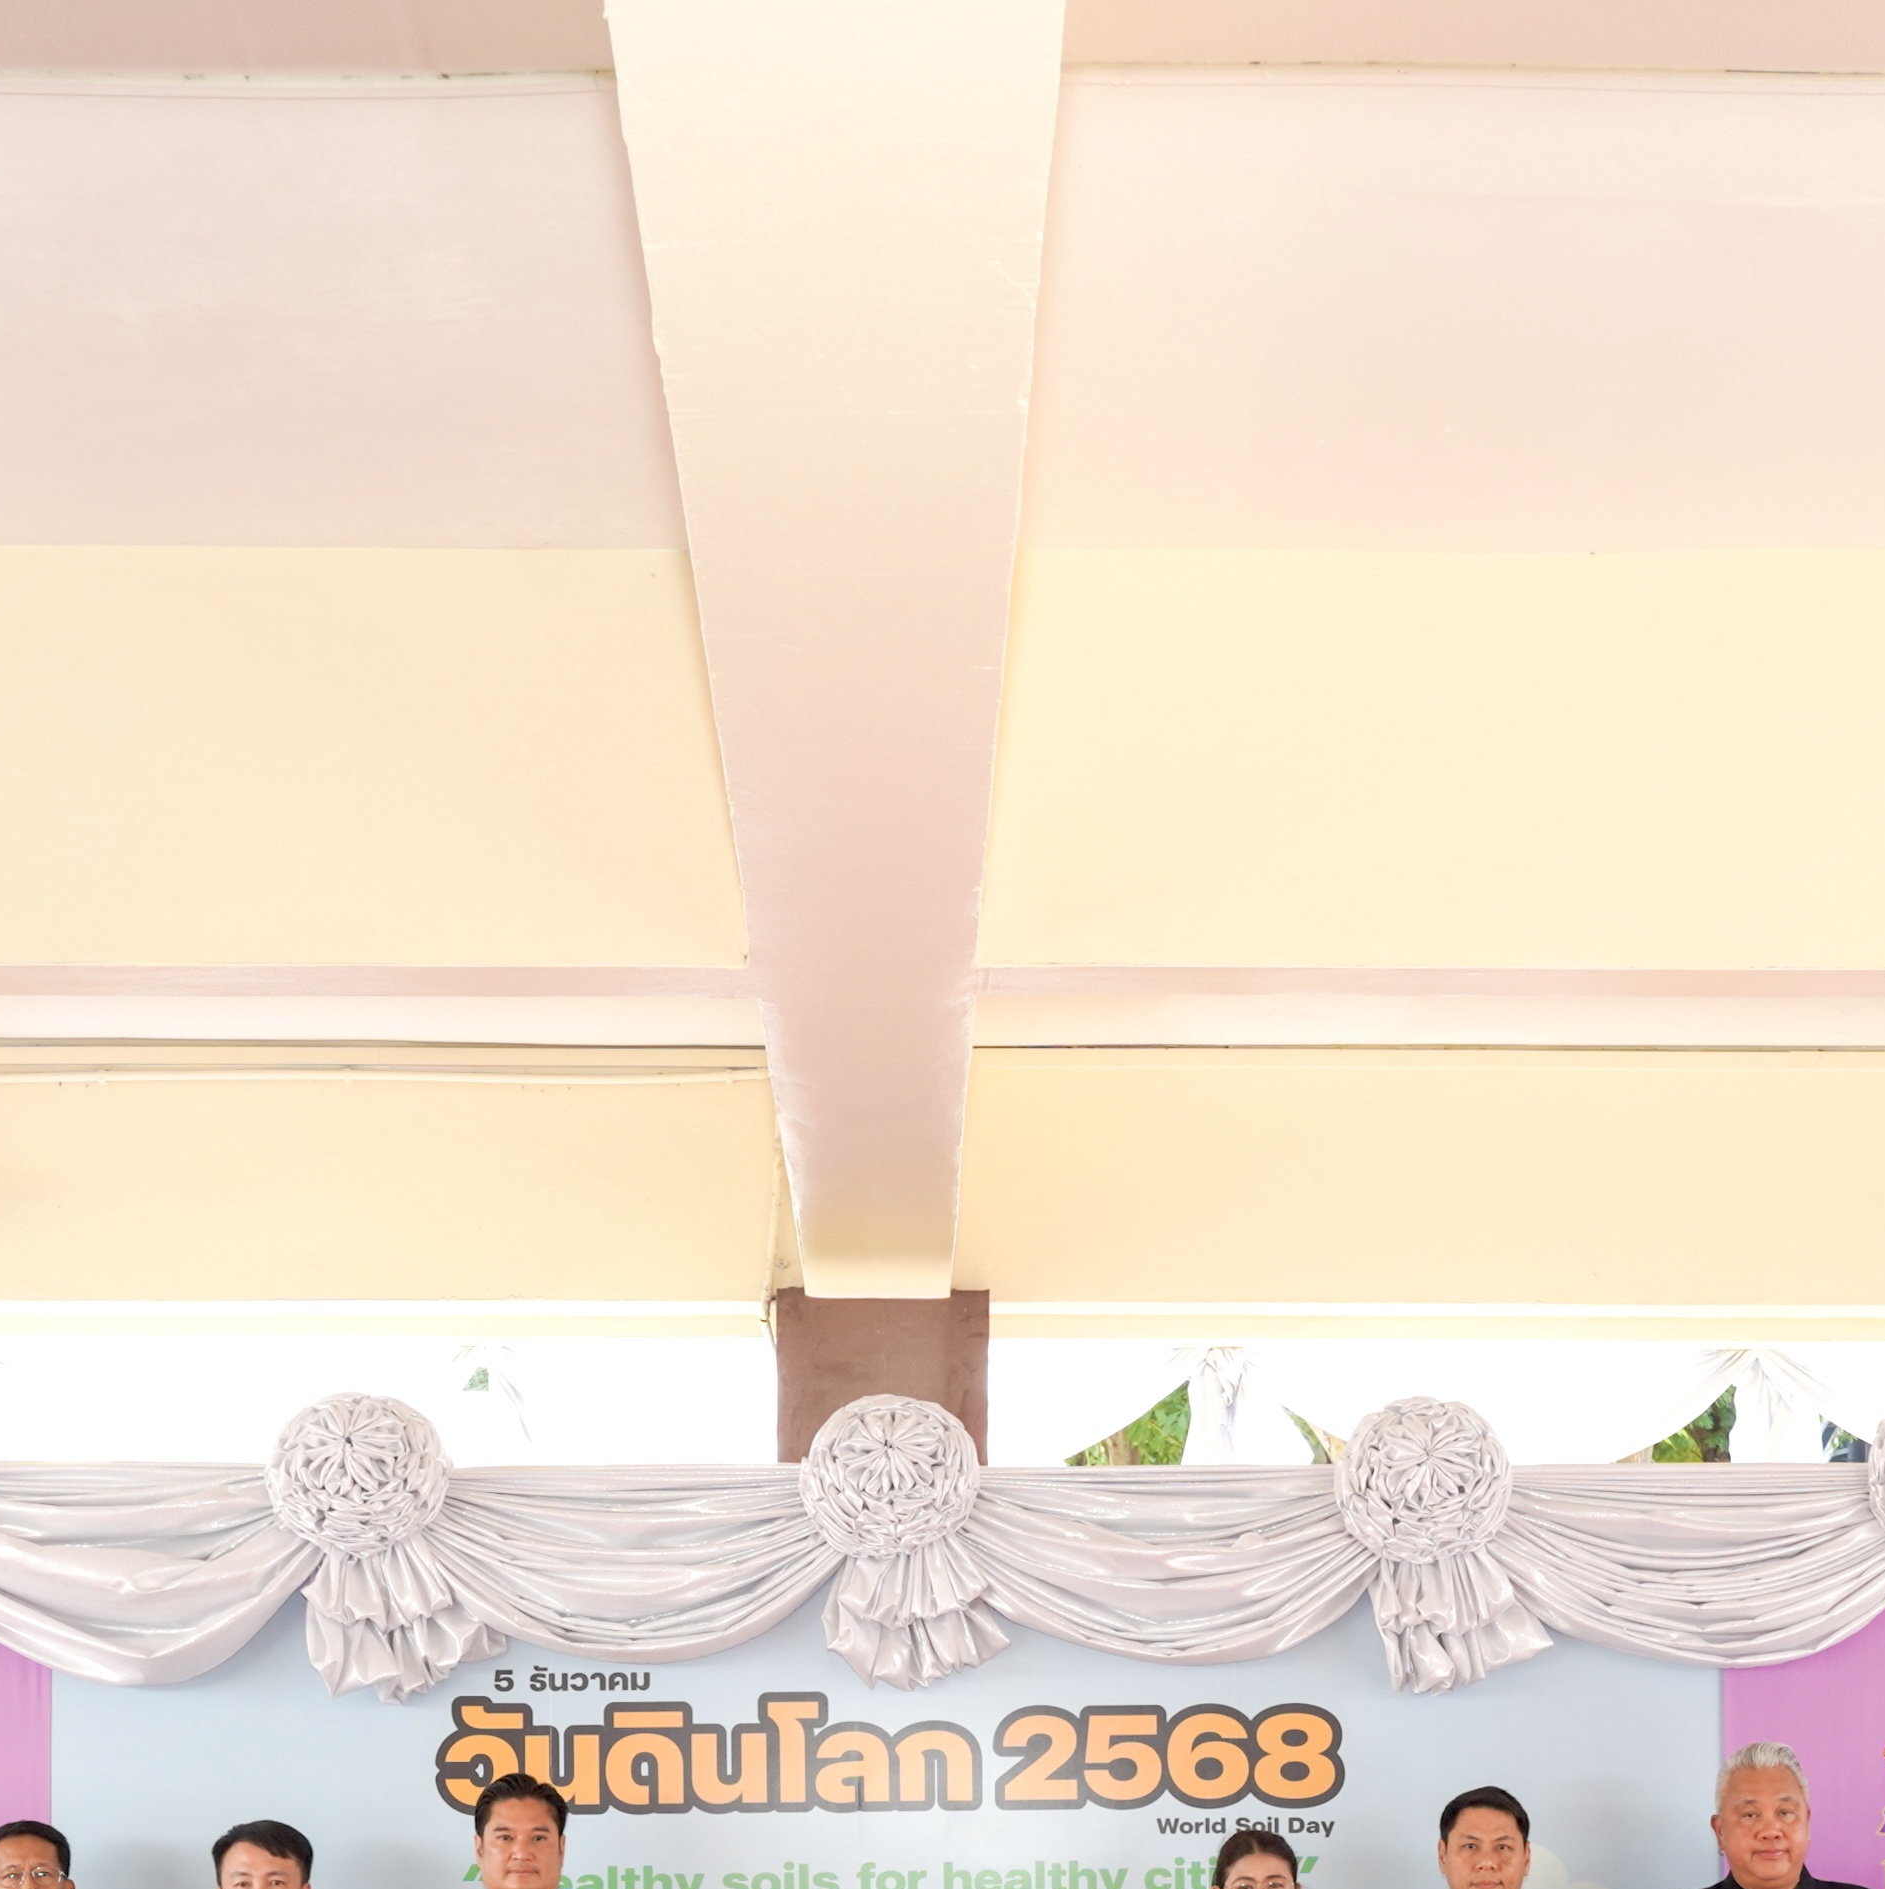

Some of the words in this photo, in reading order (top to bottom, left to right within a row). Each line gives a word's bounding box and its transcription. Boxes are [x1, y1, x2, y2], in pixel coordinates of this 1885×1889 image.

[493, 1669, 514, 1692] 5
[529, 1665, 651, 1692] ธันวาคม
[436, 1692, 983, 1814] วันดินโลก
[993, 1703, 1345, 1810] 2568
[1157, 1817, 1226, 1834] World
[1235, 1816, 1280, 1834] Soil
[1288, 1817, 1335, 1838] Day
